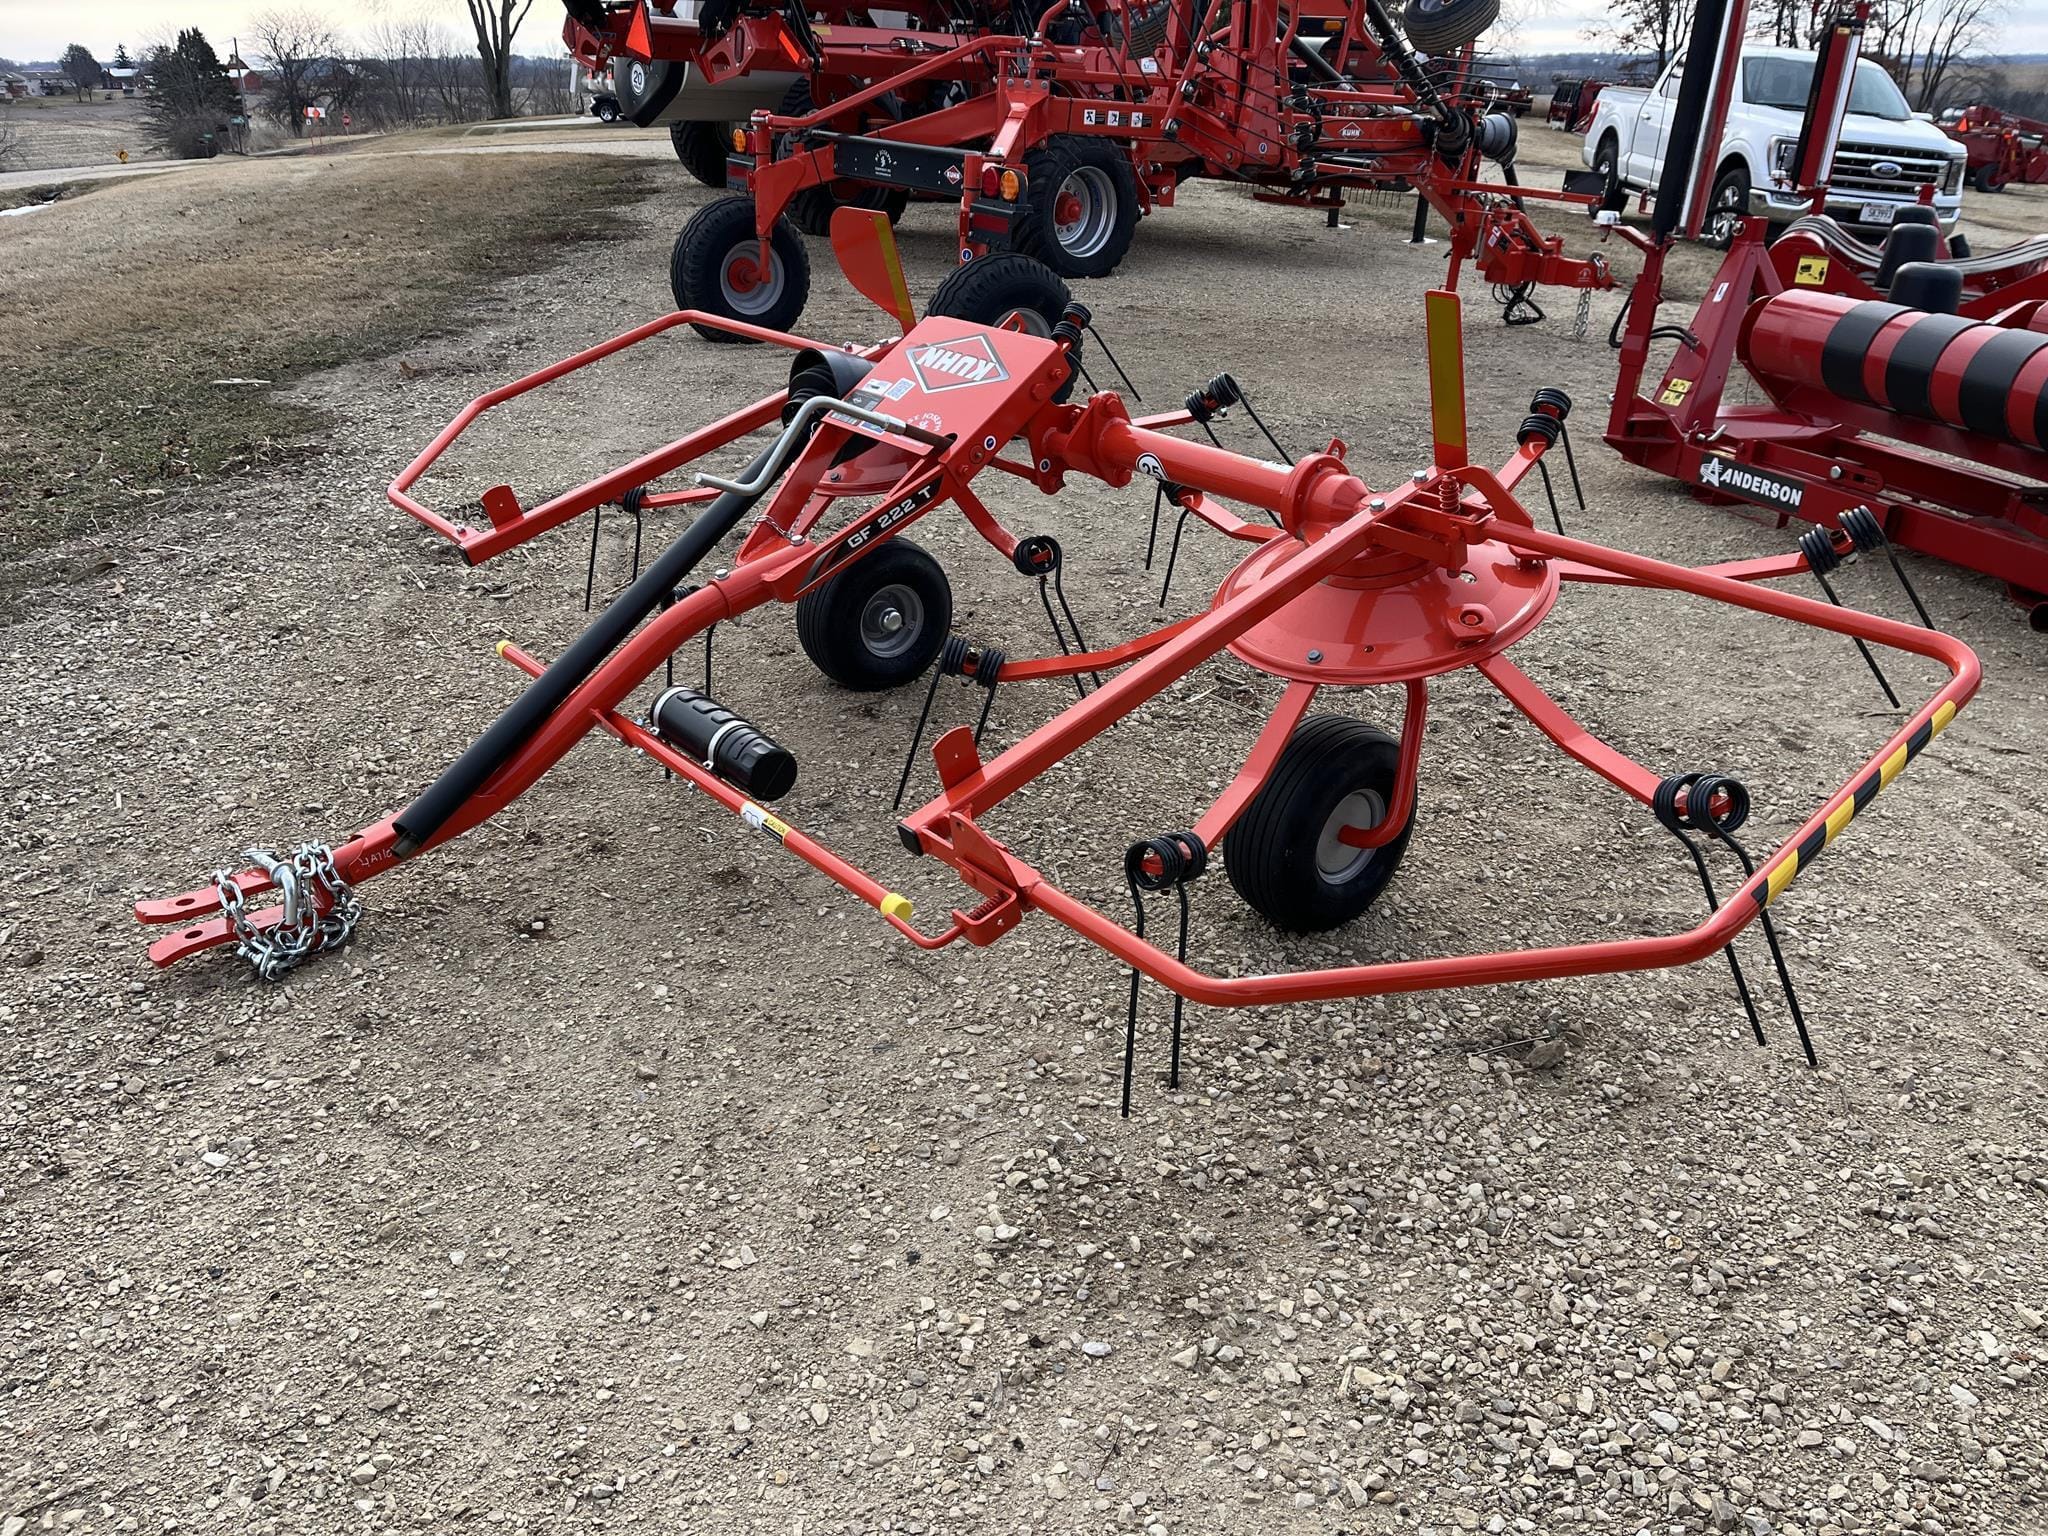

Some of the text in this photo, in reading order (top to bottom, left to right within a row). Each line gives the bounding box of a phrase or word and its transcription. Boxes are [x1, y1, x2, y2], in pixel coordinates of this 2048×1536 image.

[633, 70, 643, 86] 20
[1341, 128, 1361, 137] KUHN
[946, 171, 960, 180] KUHN
[916, 345, 997, 382] KUHN
[1142, 462, 1164, 484] 25
[1720, 468, 1803, 507] ANDERSON
[847, 485, 931, 549] GF 222 T
